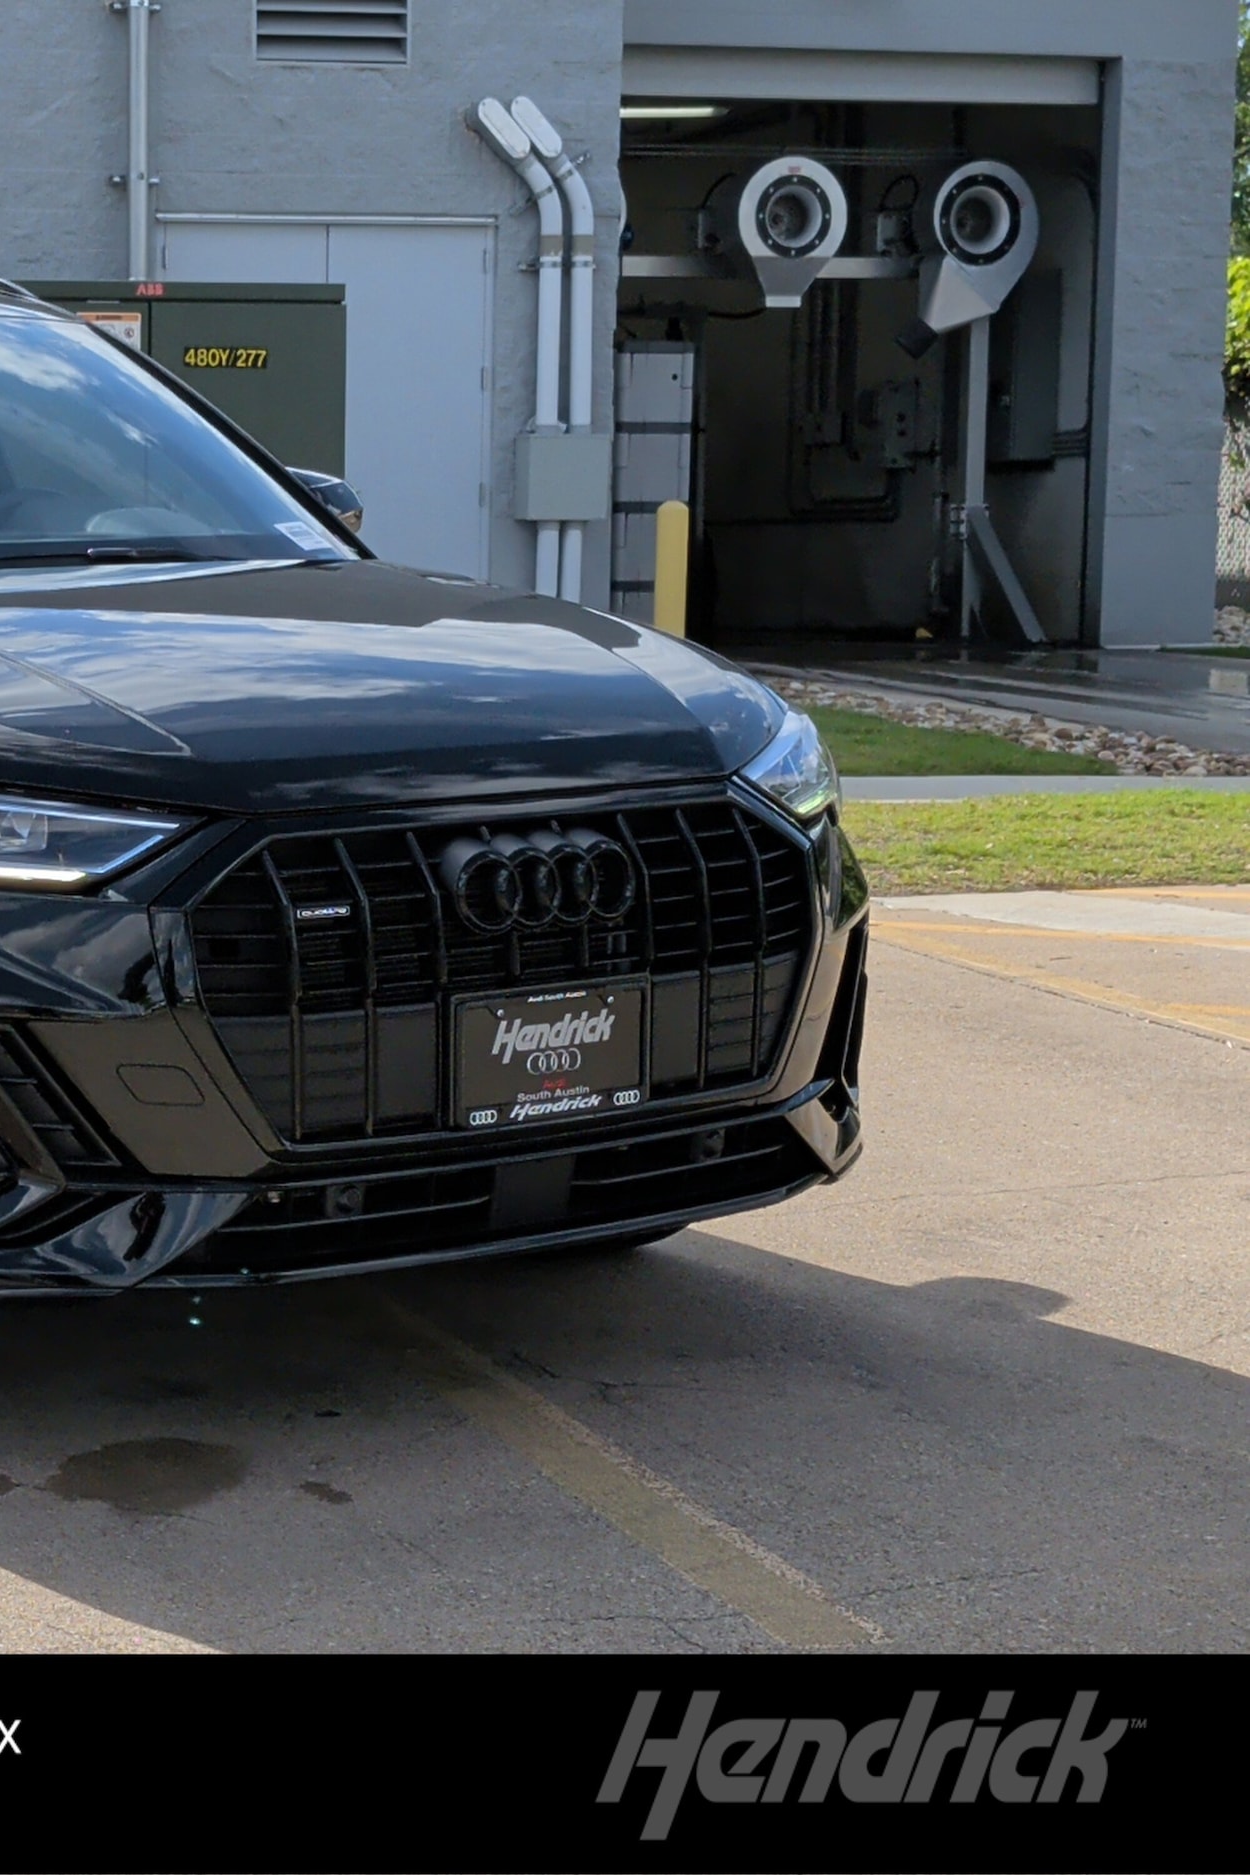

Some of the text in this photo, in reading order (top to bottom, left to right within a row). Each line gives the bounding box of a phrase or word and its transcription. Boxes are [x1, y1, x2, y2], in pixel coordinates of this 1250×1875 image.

[136, 283, 164, 296] ABB
[184, 348, 267, 368] 480Y/277
[492, 1009, 616, 1064] Hendrick
[517, 1085, 590, 1103] South Austin
[510, 1094, 602, 1121] Hendrick
